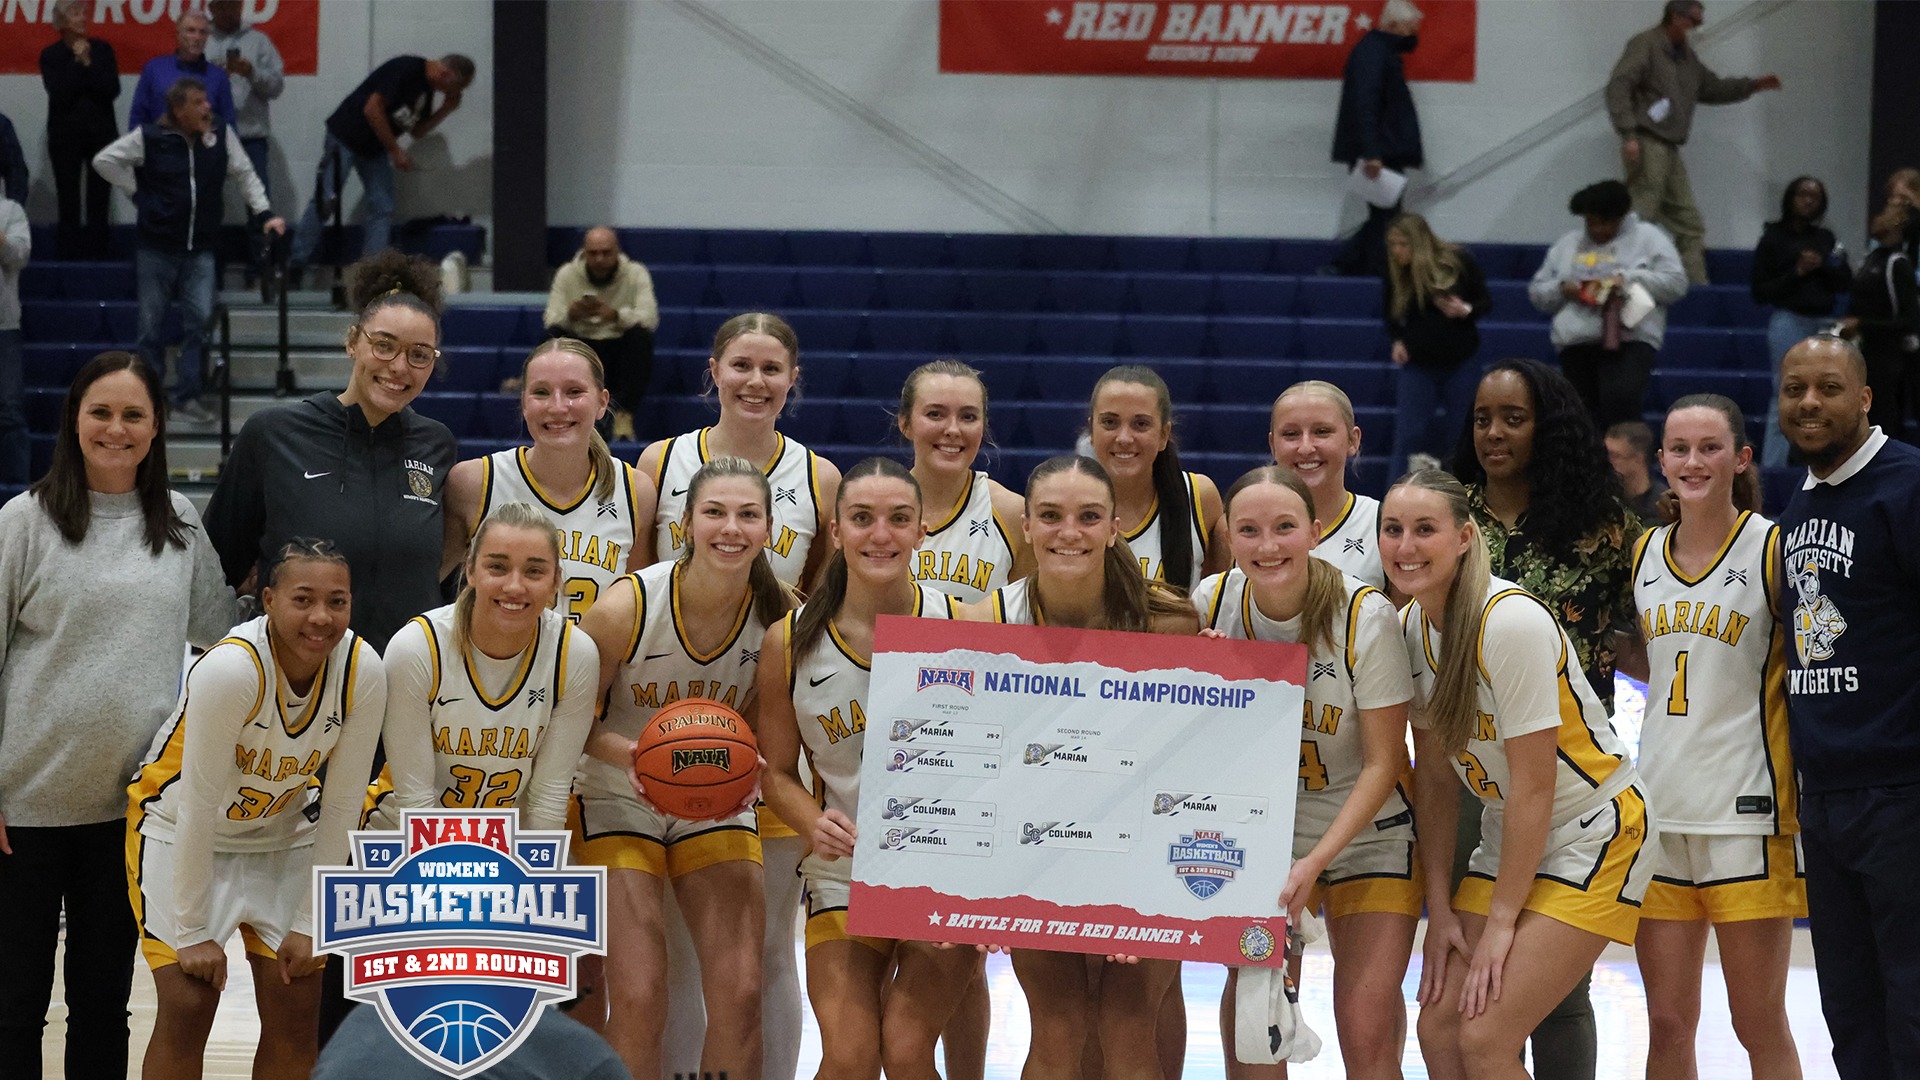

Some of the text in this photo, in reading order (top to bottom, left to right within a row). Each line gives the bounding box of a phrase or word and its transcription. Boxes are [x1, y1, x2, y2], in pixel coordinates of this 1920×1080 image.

[1064, 2, 1352, 45] RED BANNER
[556, 529, 621, 574] RIAN
[1784, 518, 1855, 558] MARIAN
[908, 550, 995, 592] RIAN
[1640, 600, 1750, 647] MARIAN
[918, 668, 1256, 709] NAIA NATIONAL CHAMPIONSHIP
[1667, 651, 1689, 716] 1
[1787, 666, 1859, 695] NIGHTS
[658, 713, 738, 738] SPALDING
[920, 727, 954, 737] MARIAN
[672, 747, 730, 775] NAIA
[917, 757, 955, 768] HASKELL
[1053, 752, 1088, 763] MARIAN
[440, 764, 523, 808] 32
[912, 805, 956, 816] COLUMBIA
[1182, 801, 1217, 812] MARIAN
[910, 835, 947, 846] CARROLL
[1048, 829, 1092, 839] COLUMBIA
[1195, 831, 1221, 843] NAIA
[1172, 847, 1241, 864] BASKETBALL
[946, 913, 1184, 944] BATTLE FOR THE RED BANNER
